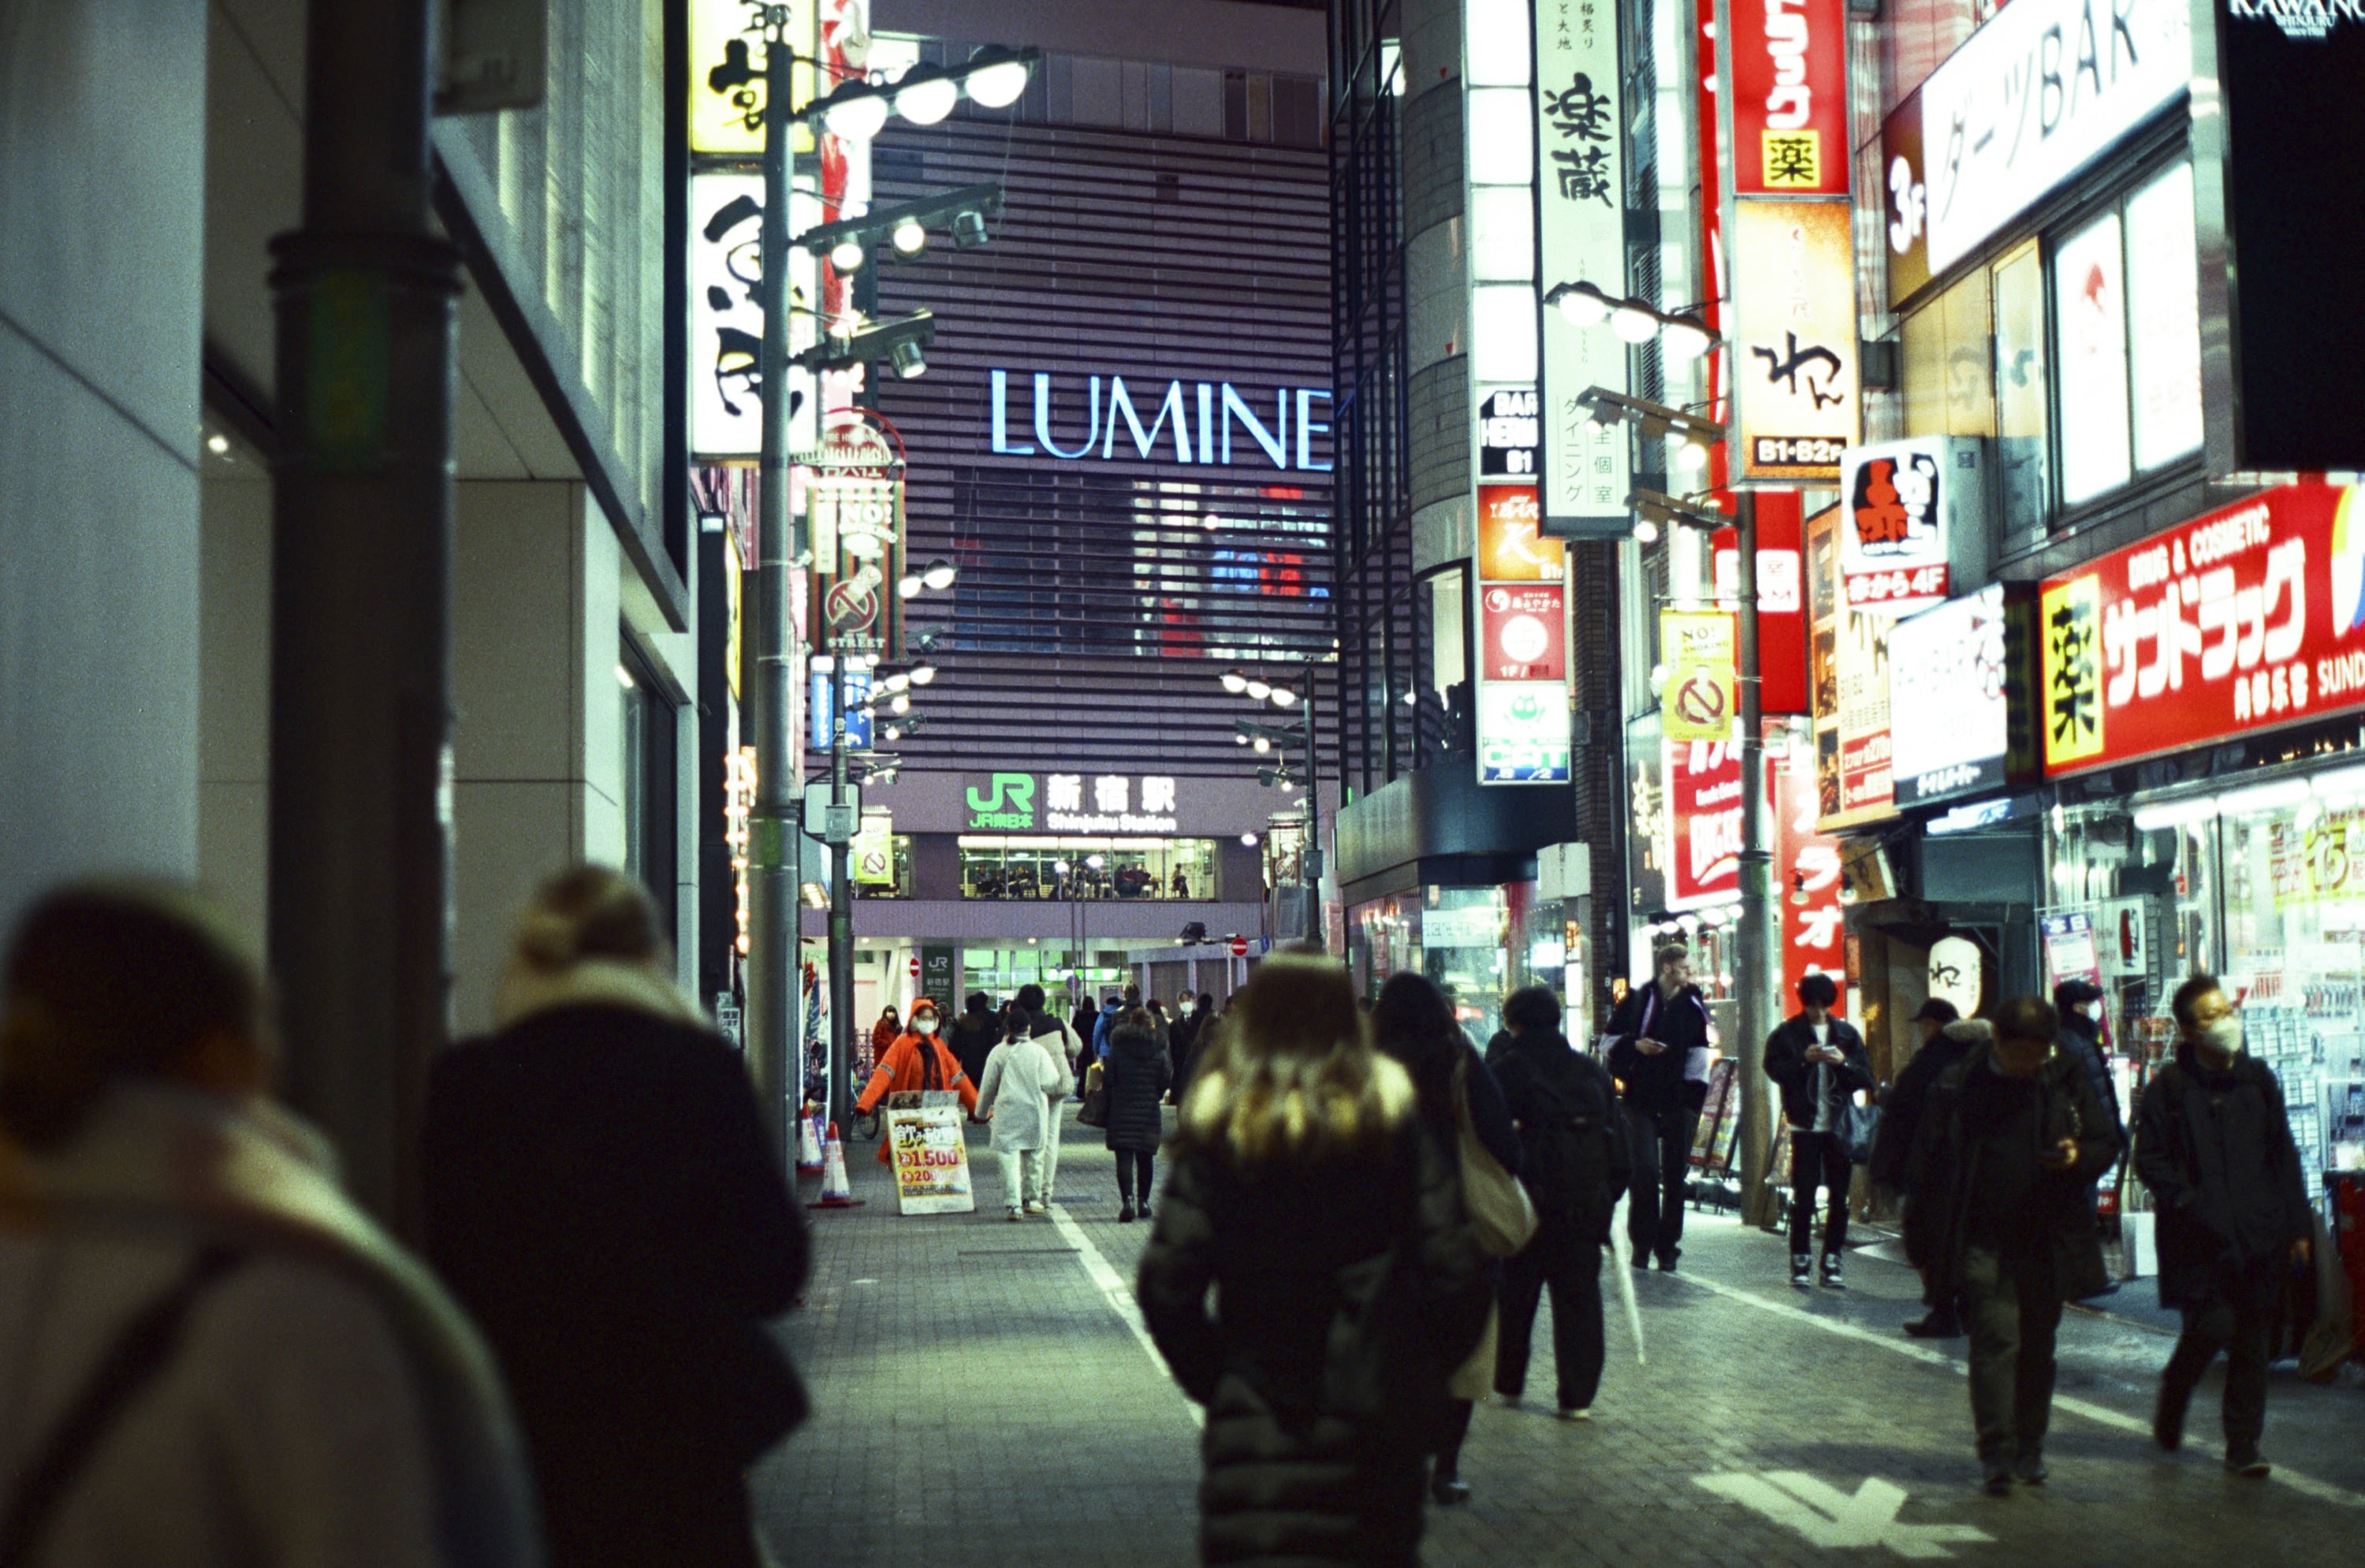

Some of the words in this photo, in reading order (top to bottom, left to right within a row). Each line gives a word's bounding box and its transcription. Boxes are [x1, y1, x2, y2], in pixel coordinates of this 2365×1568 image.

[1543, 72, 1614, 208] 楽蔵
[1770, 139, 1814, 181] 薬
[1890, 155, 1925, 255] 3F
[1751, 330, 1844, 411] わん
[992, 370, 1333, 471] LUMINE
[1495, 392, 1537, 415] BAR
[1564, 397, 1583, 503] ダイニング
[1499, 503, 1538, 519] BAR
[2189, 502, 2270, 568] COSMETIC
[1848, 576, 1911, 604] 赤から
[1912, 568, 1946, 596] 4F
[1682, 626, 1715, 643] NO!
[2102, 536, 2306, 709] サンドラッグ
[828, 637, 885, 650] STREET
[966, 773, 1034, 812] JR
[1047, 773, 1176, 812] 新宿駅
[969, 813, 1034, 829] JR東日本
[1047, 812, 1118, 833] Shinjuku
[1119, 813, 1177, 832] Station
[928, 955, 948, 969] JR
[911, 1149, 959, 1168] 1,500
